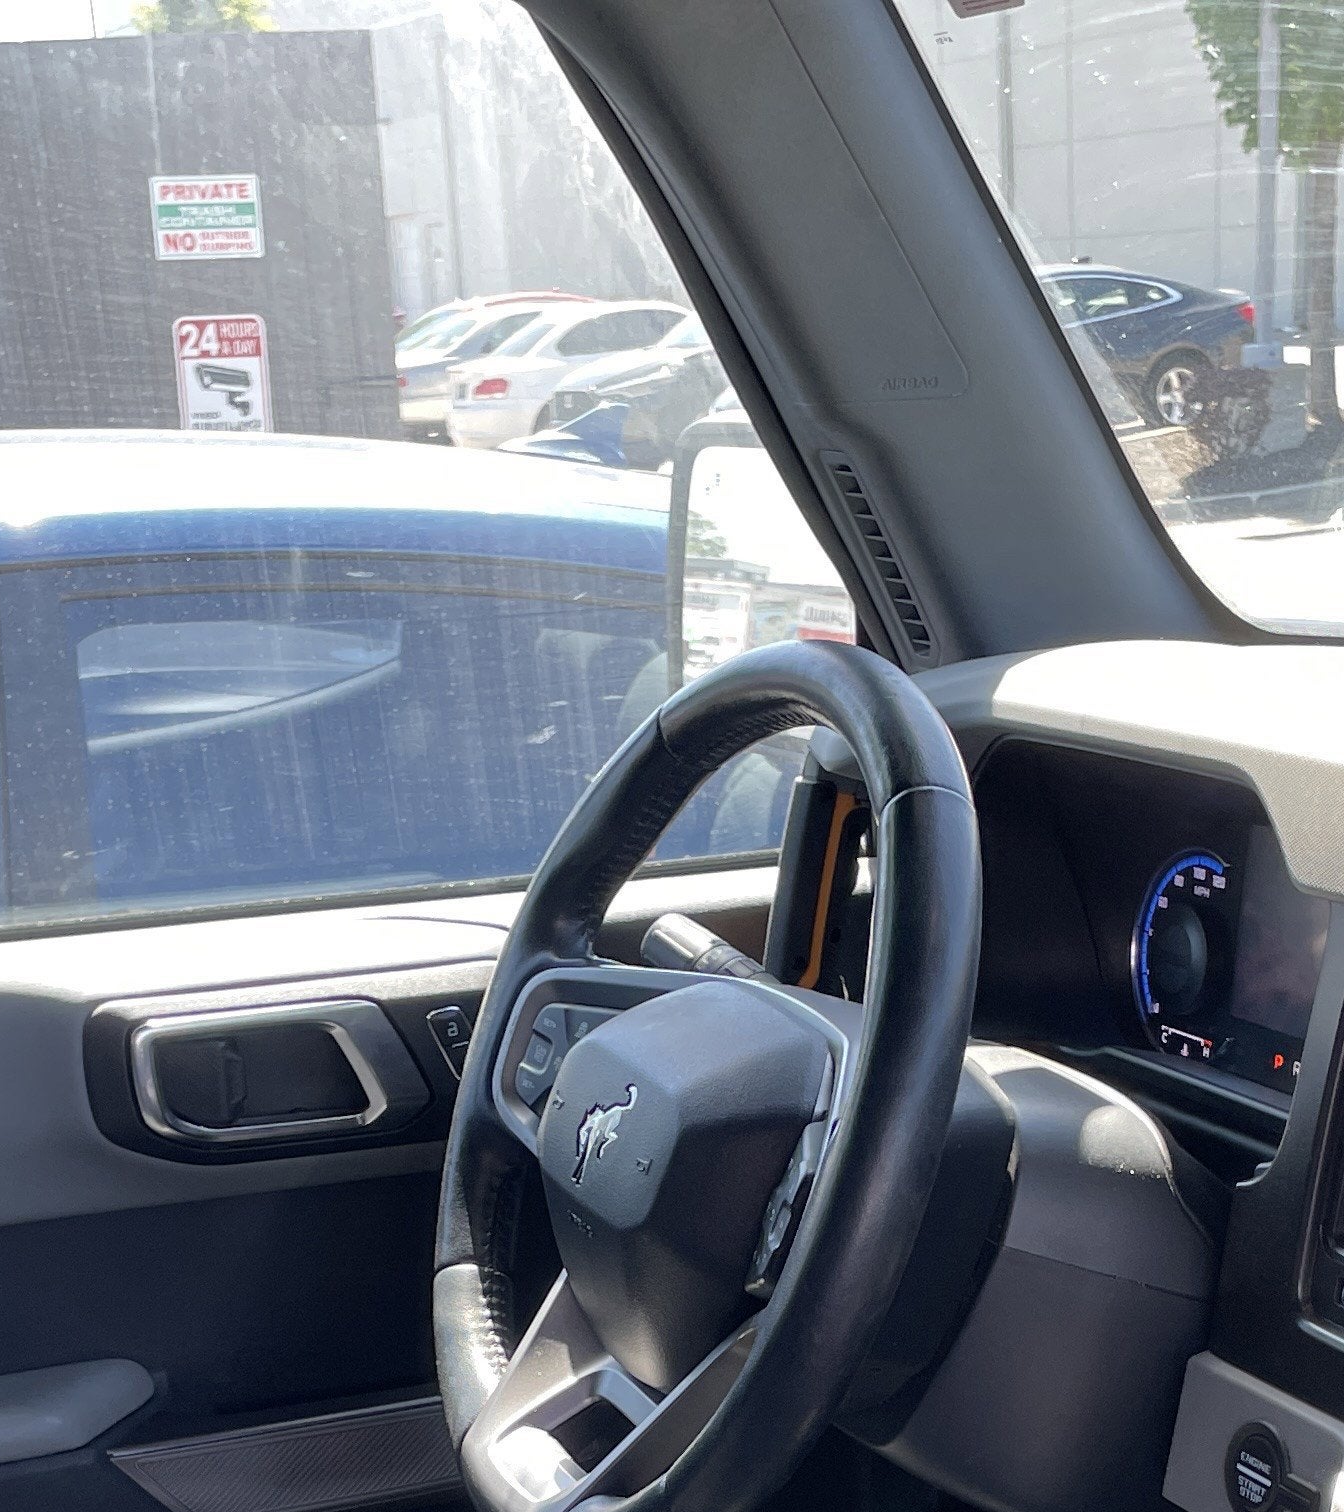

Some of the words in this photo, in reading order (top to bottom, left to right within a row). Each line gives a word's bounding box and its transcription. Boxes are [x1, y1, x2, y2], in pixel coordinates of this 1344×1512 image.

[160, 183, 249, 200] PRIVATE
[163, 231, 196, 253] NO
[179, 322, 221, 357] 24
[1241, 1452, 1271, 1475] ENGINE
[1239, 1476, 1266, 1496] START
[1240, 1486, 1263, 1503] STOP
